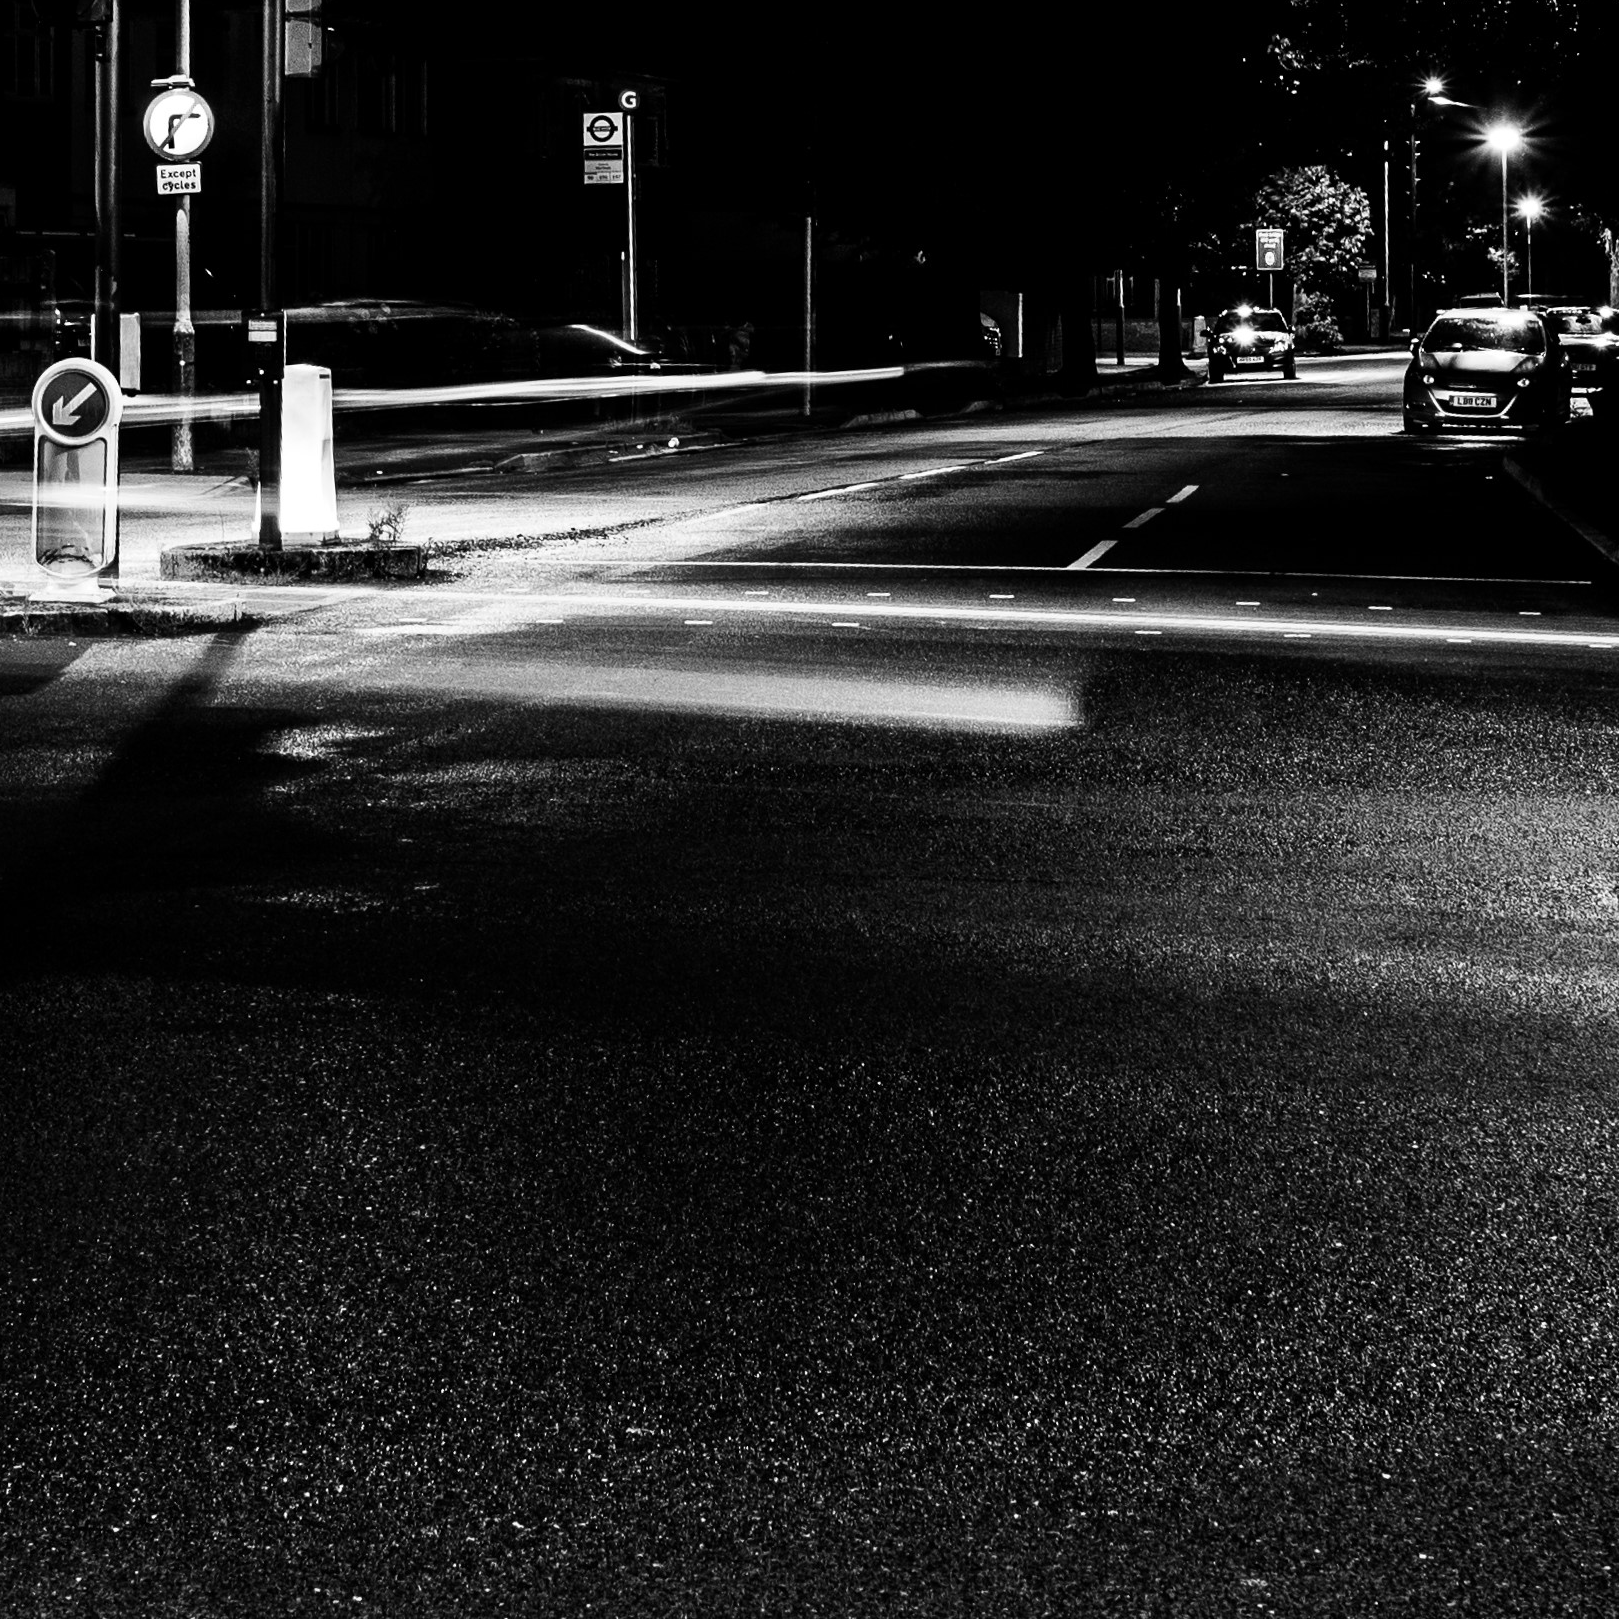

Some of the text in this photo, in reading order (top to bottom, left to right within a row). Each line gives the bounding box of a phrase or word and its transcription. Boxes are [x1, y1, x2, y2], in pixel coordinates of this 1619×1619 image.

[621, 91, 637, 109] G
[160, 168, 196, 179] Except
[162, 180, 196, 192] cycles
